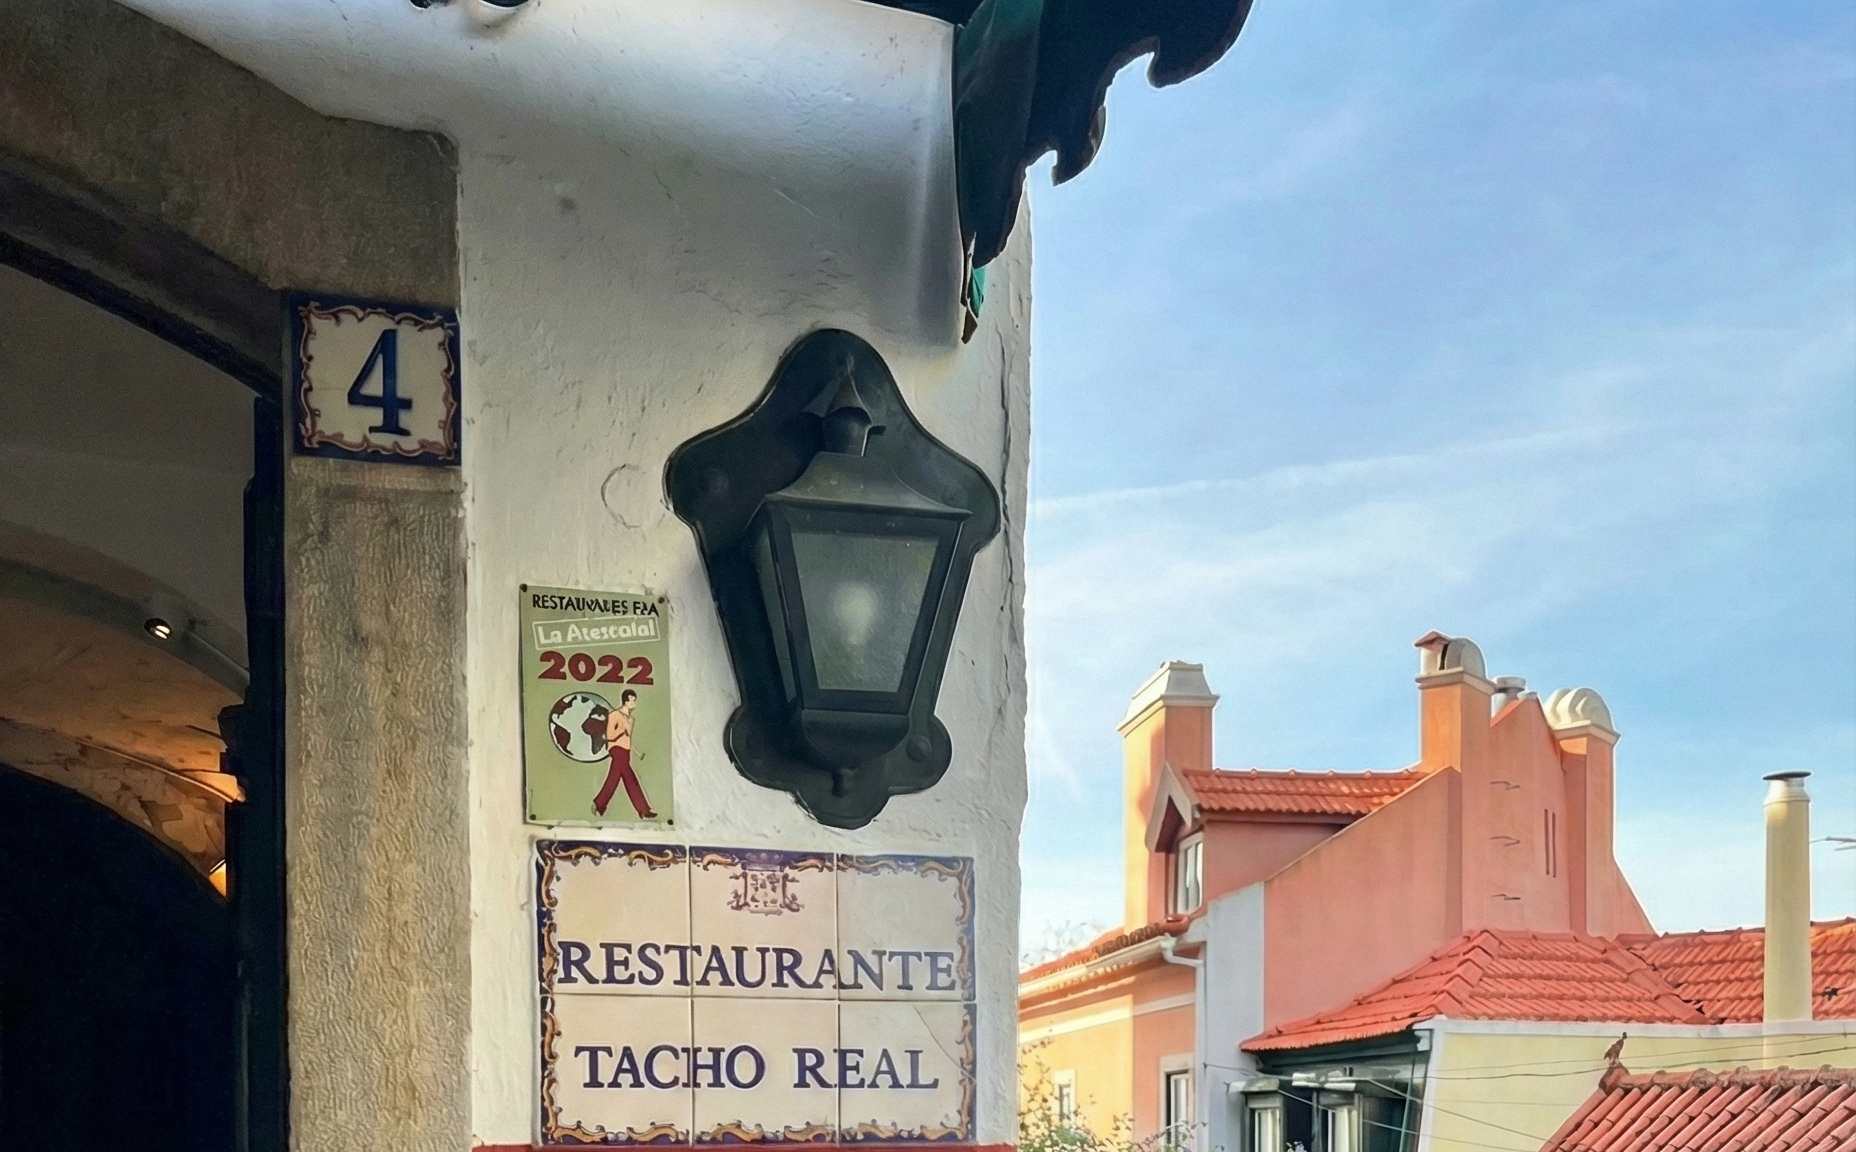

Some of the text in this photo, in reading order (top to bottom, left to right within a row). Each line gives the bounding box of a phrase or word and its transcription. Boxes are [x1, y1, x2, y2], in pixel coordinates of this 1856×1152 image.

[347, 328, 413, 436] 4
[537, 625, 563, 645] La
[537, 650, 654, 686] 2022
[557, 941, 957, 991] RESTAURANTE
[574, 1043, 940, 1090] TACHO REAL
